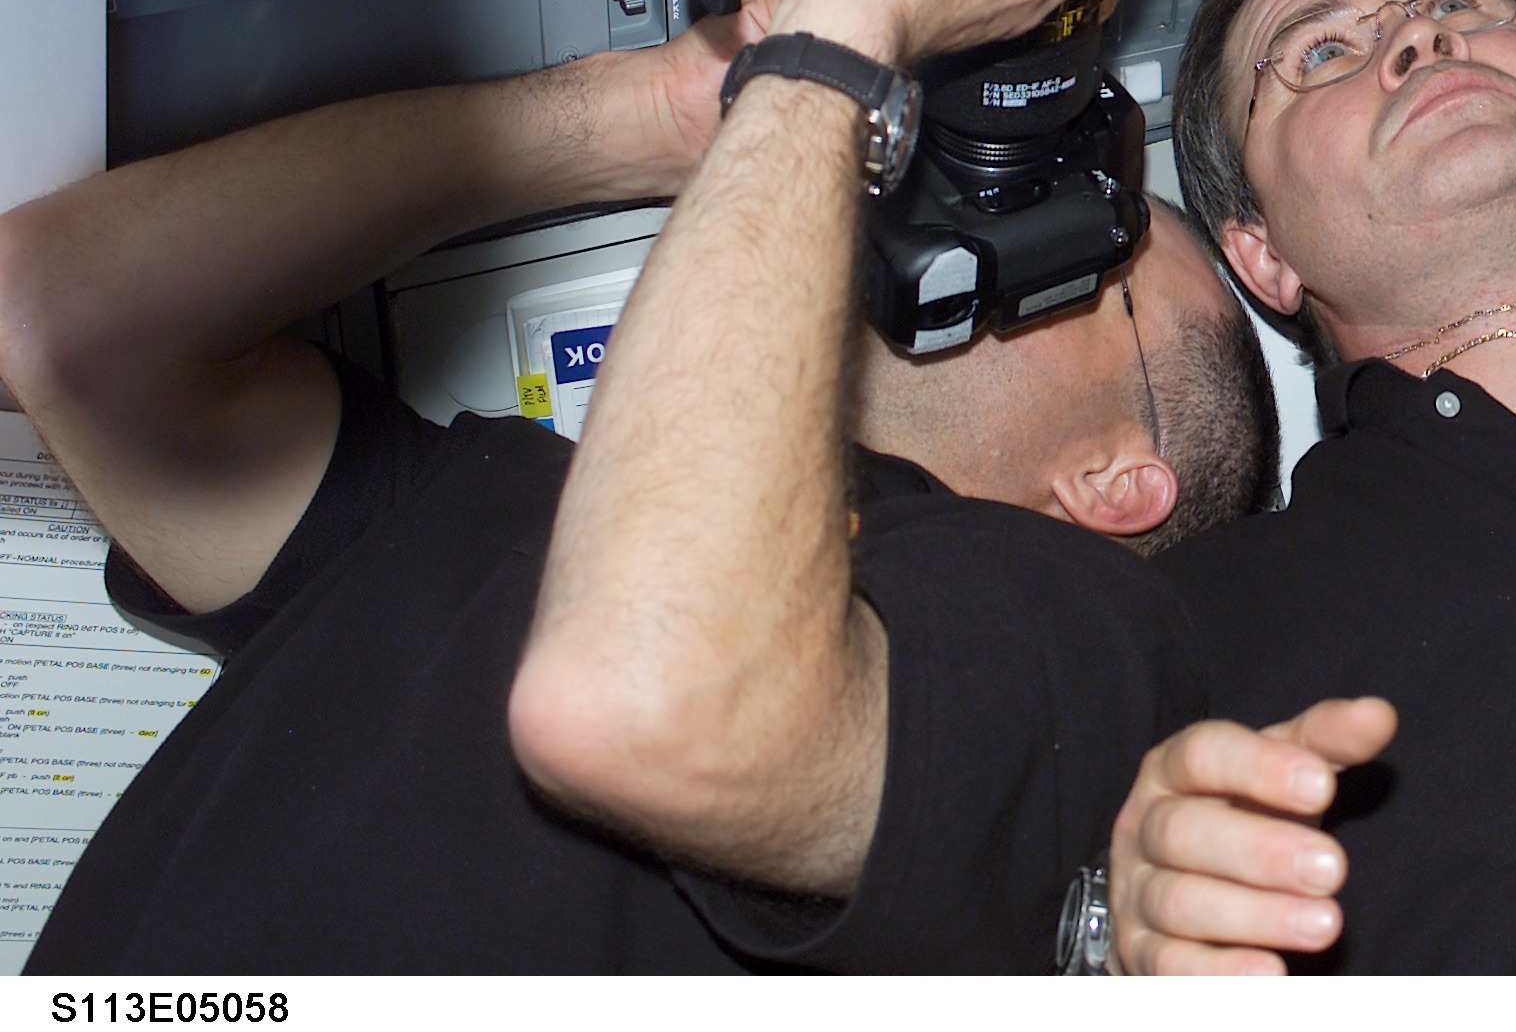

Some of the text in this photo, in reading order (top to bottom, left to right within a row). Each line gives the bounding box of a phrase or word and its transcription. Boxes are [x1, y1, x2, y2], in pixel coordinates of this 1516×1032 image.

[48, 523, 90, 534] CAUTION
[66, 661, 84, 669] POS
[86, 662, 110, 670] BASE
